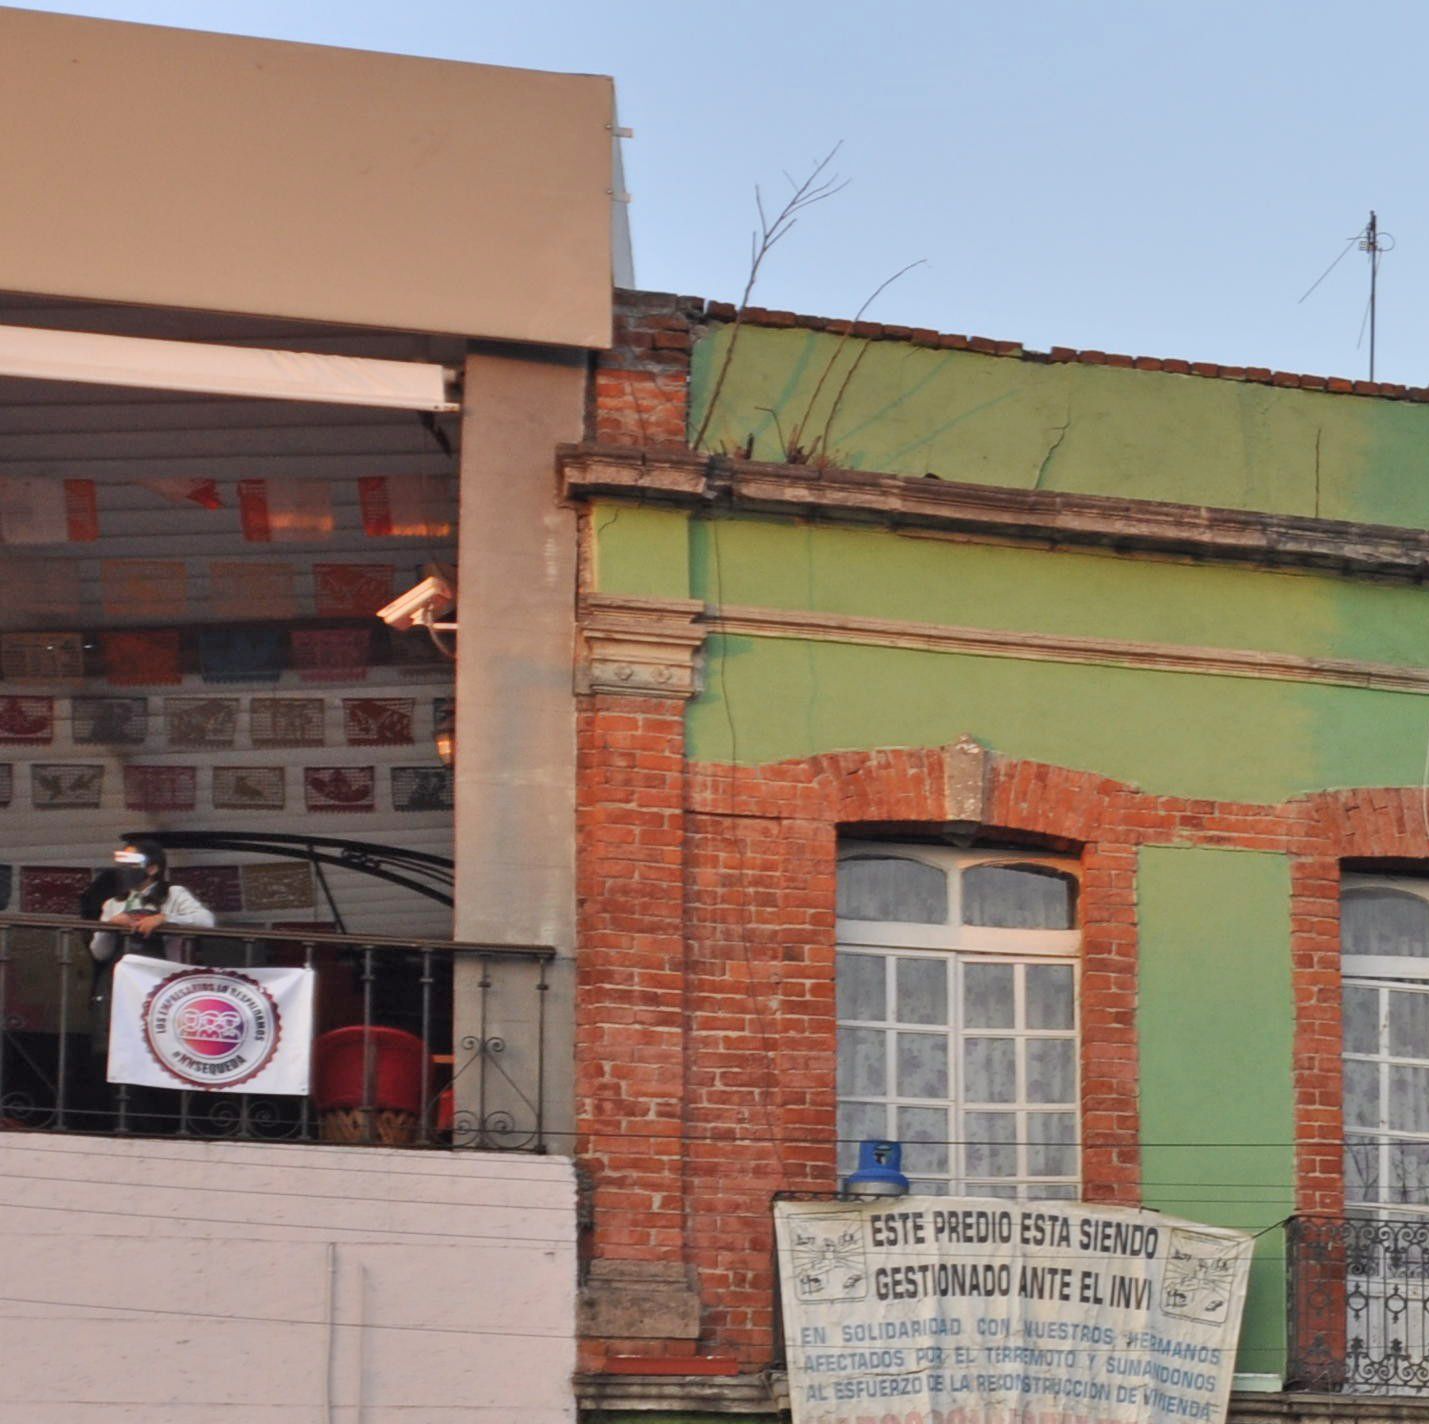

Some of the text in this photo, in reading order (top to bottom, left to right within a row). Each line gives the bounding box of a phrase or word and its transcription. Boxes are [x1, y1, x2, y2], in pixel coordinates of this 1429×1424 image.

[870, 1210, 1159, 1260] ESTE PREDIO ESTA SIENDO
[875, 1263, 1152, 1311] GESTIONADO ANTE EL INVI
[801, 1317, 1222, 1365] EN SOLIDARIDAD CON NUESTROS HERMANOS
[804, 1346, 1217, 1393] AFECTADOS POR EL TERREMOTO Y SUMANDONOS
[806, 1384, 828, 1402] AL
[834, 1376, 923, 1400] ESFUERZO
[928, 1374, 944, 1392] DE
[950, 1374, 970, 1392] LA
[1116, 1385, 1137, 1404] DE
